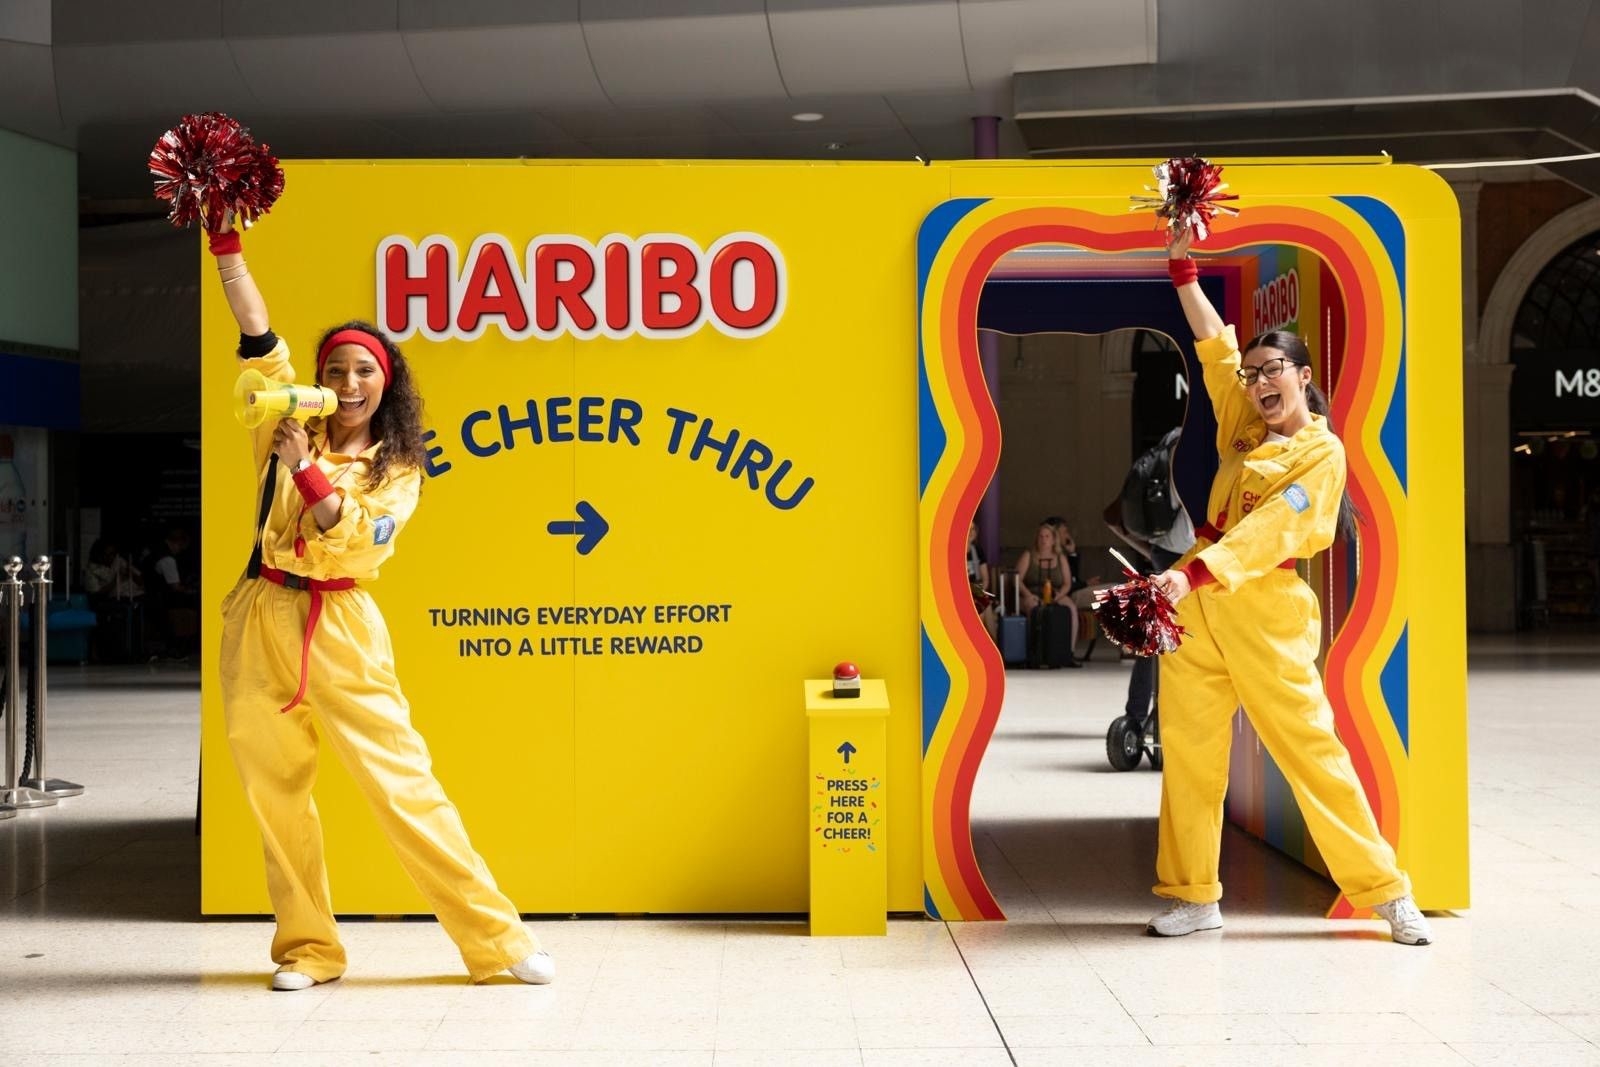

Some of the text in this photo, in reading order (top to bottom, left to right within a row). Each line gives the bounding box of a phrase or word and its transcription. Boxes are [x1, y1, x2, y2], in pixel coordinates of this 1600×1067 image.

[384, 240, 779, 333] HARIBO
[1254, 271, 1298, 335] HARIBO
[298, 400, 324, 409] HARIBO
[460, 396, 644, 458] CHEER
[665, 407, 815, 511] THRU
[428, 604, 732, 627] TURNING EVERYDAY EFFORT
[458, 635, 704, 657] INTO A LITTLE REWARD
[826, 779, 868, 792] PRESS
[830, 795, 865, 808] HERE
[826, 811, 868, 824] FOR A
[823, 828, 871, 840] CHEER!
